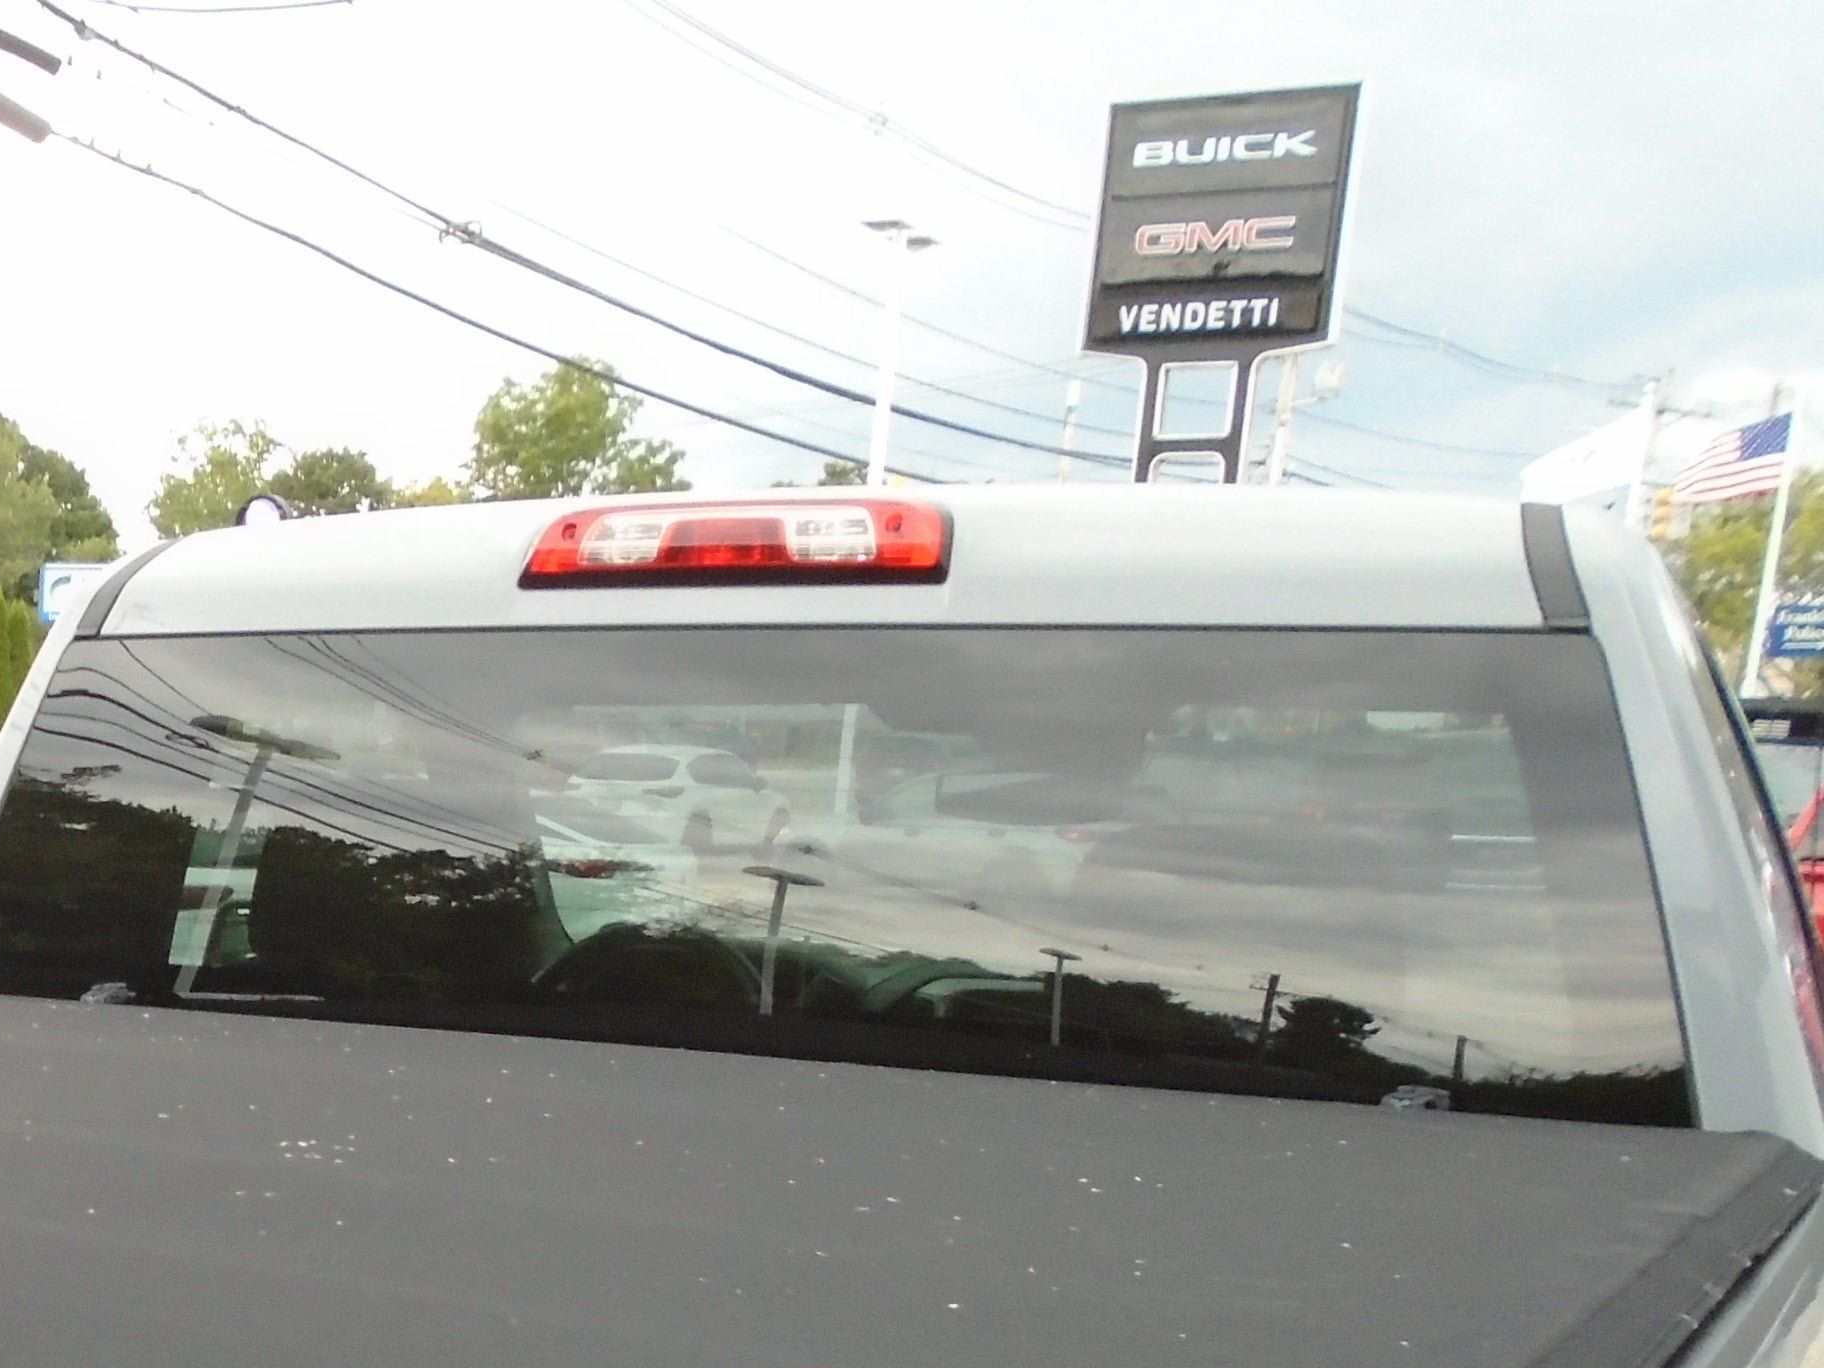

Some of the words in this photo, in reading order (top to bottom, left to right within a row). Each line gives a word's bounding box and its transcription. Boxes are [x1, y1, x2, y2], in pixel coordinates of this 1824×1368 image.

[1133, 130, 1318, 168] BUICK
[1134, 215, 1297, 255] GMC
[1118, 298, 1280, 335] VENDETTI
